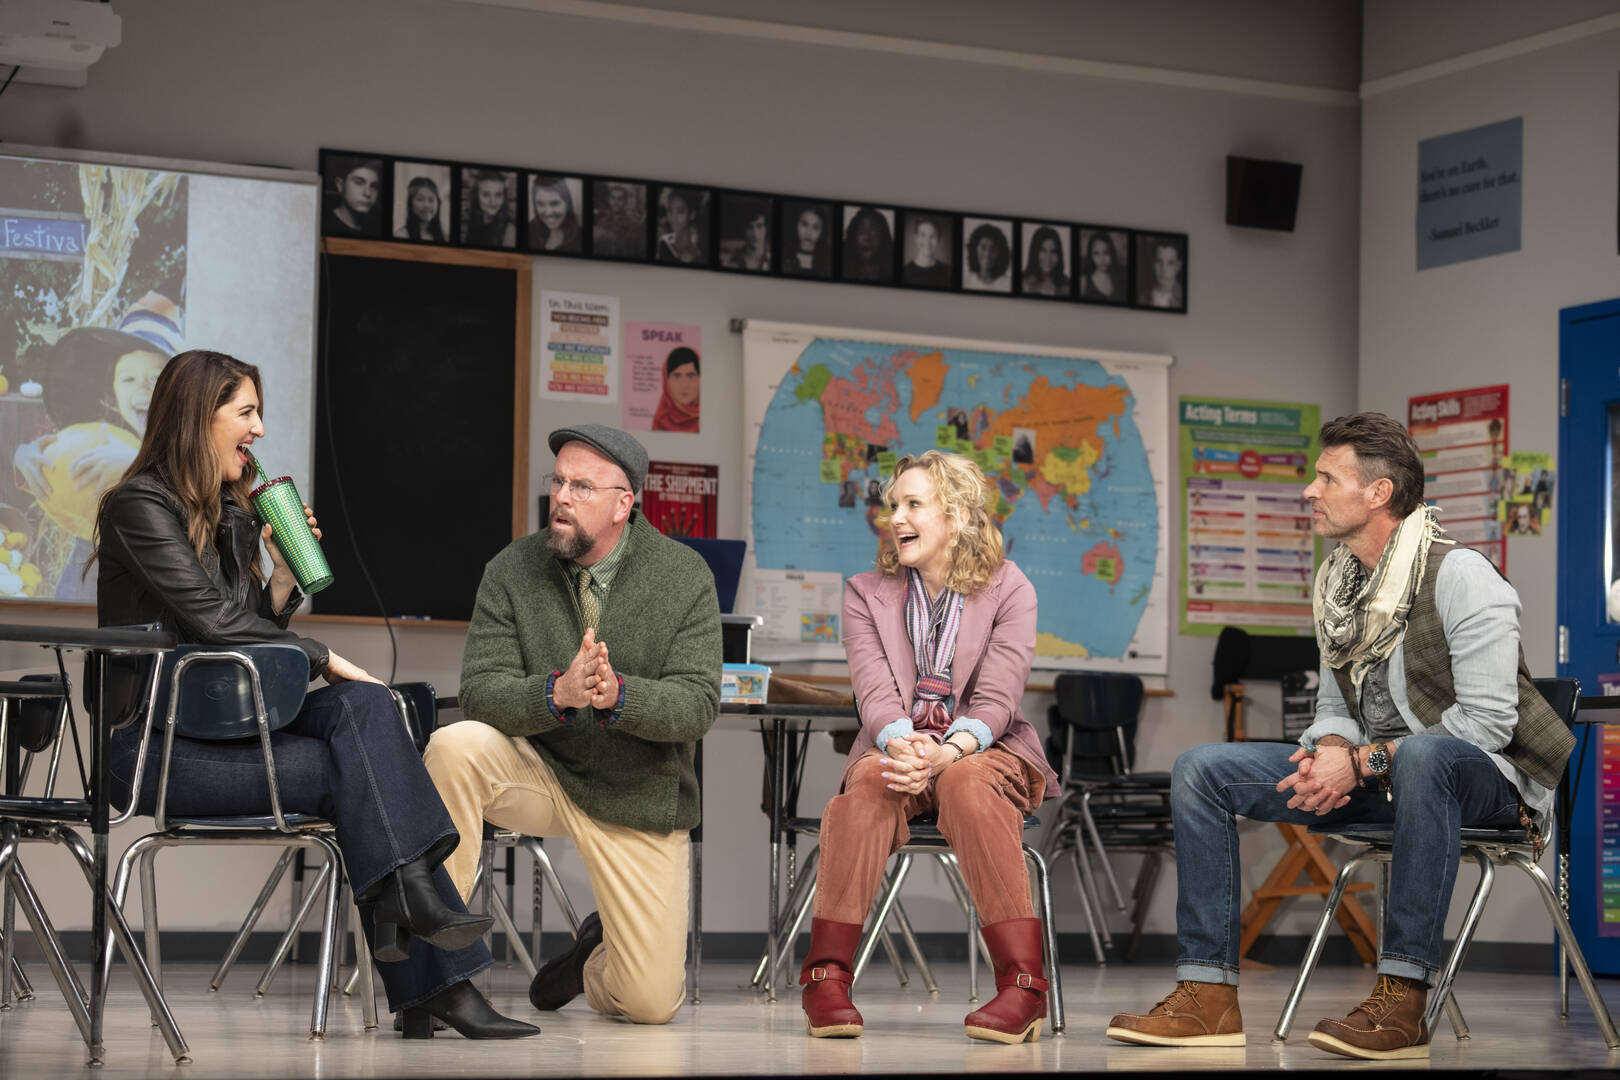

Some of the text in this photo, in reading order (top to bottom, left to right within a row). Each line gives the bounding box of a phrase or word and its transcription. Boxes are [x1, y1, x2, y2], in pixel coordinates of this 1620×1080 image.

[4, 218, 87, 253] Festival
[642, 328, 683, 342] SPEAK
[1185, 403, 1222, 426] Acting
[1223, 406, 1258, 424] Terms
[1411, 403, 1438, 422] Acting
[1438, 399, 1461, 416] Skills
[644, 473, 718, 495] THE SHIPMENT
